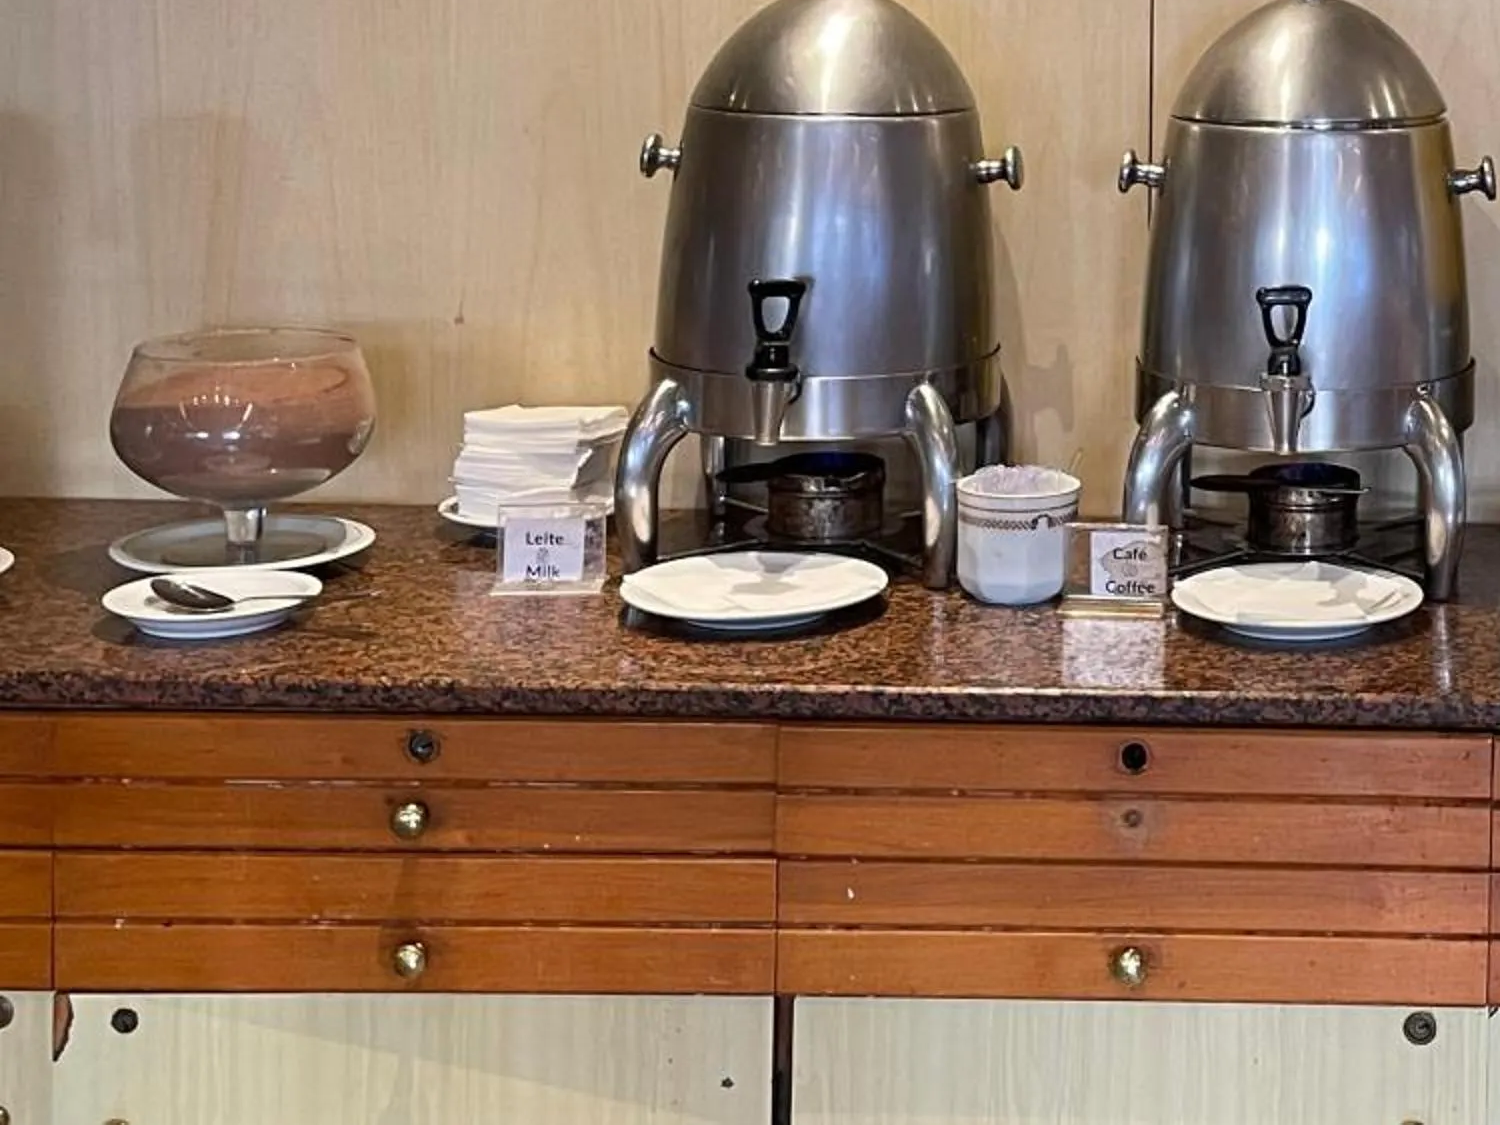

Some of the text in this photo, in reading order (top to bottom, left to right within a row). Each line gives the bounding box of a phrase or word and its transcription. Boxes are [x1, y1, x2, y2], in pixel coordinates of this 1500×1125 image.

[525, 532, 564, 546] Leite
[1113, 547, 1147, 560] Café
[526, 564, 560, 577] Milk
[1105, 580, 1155, 594] Coffee
